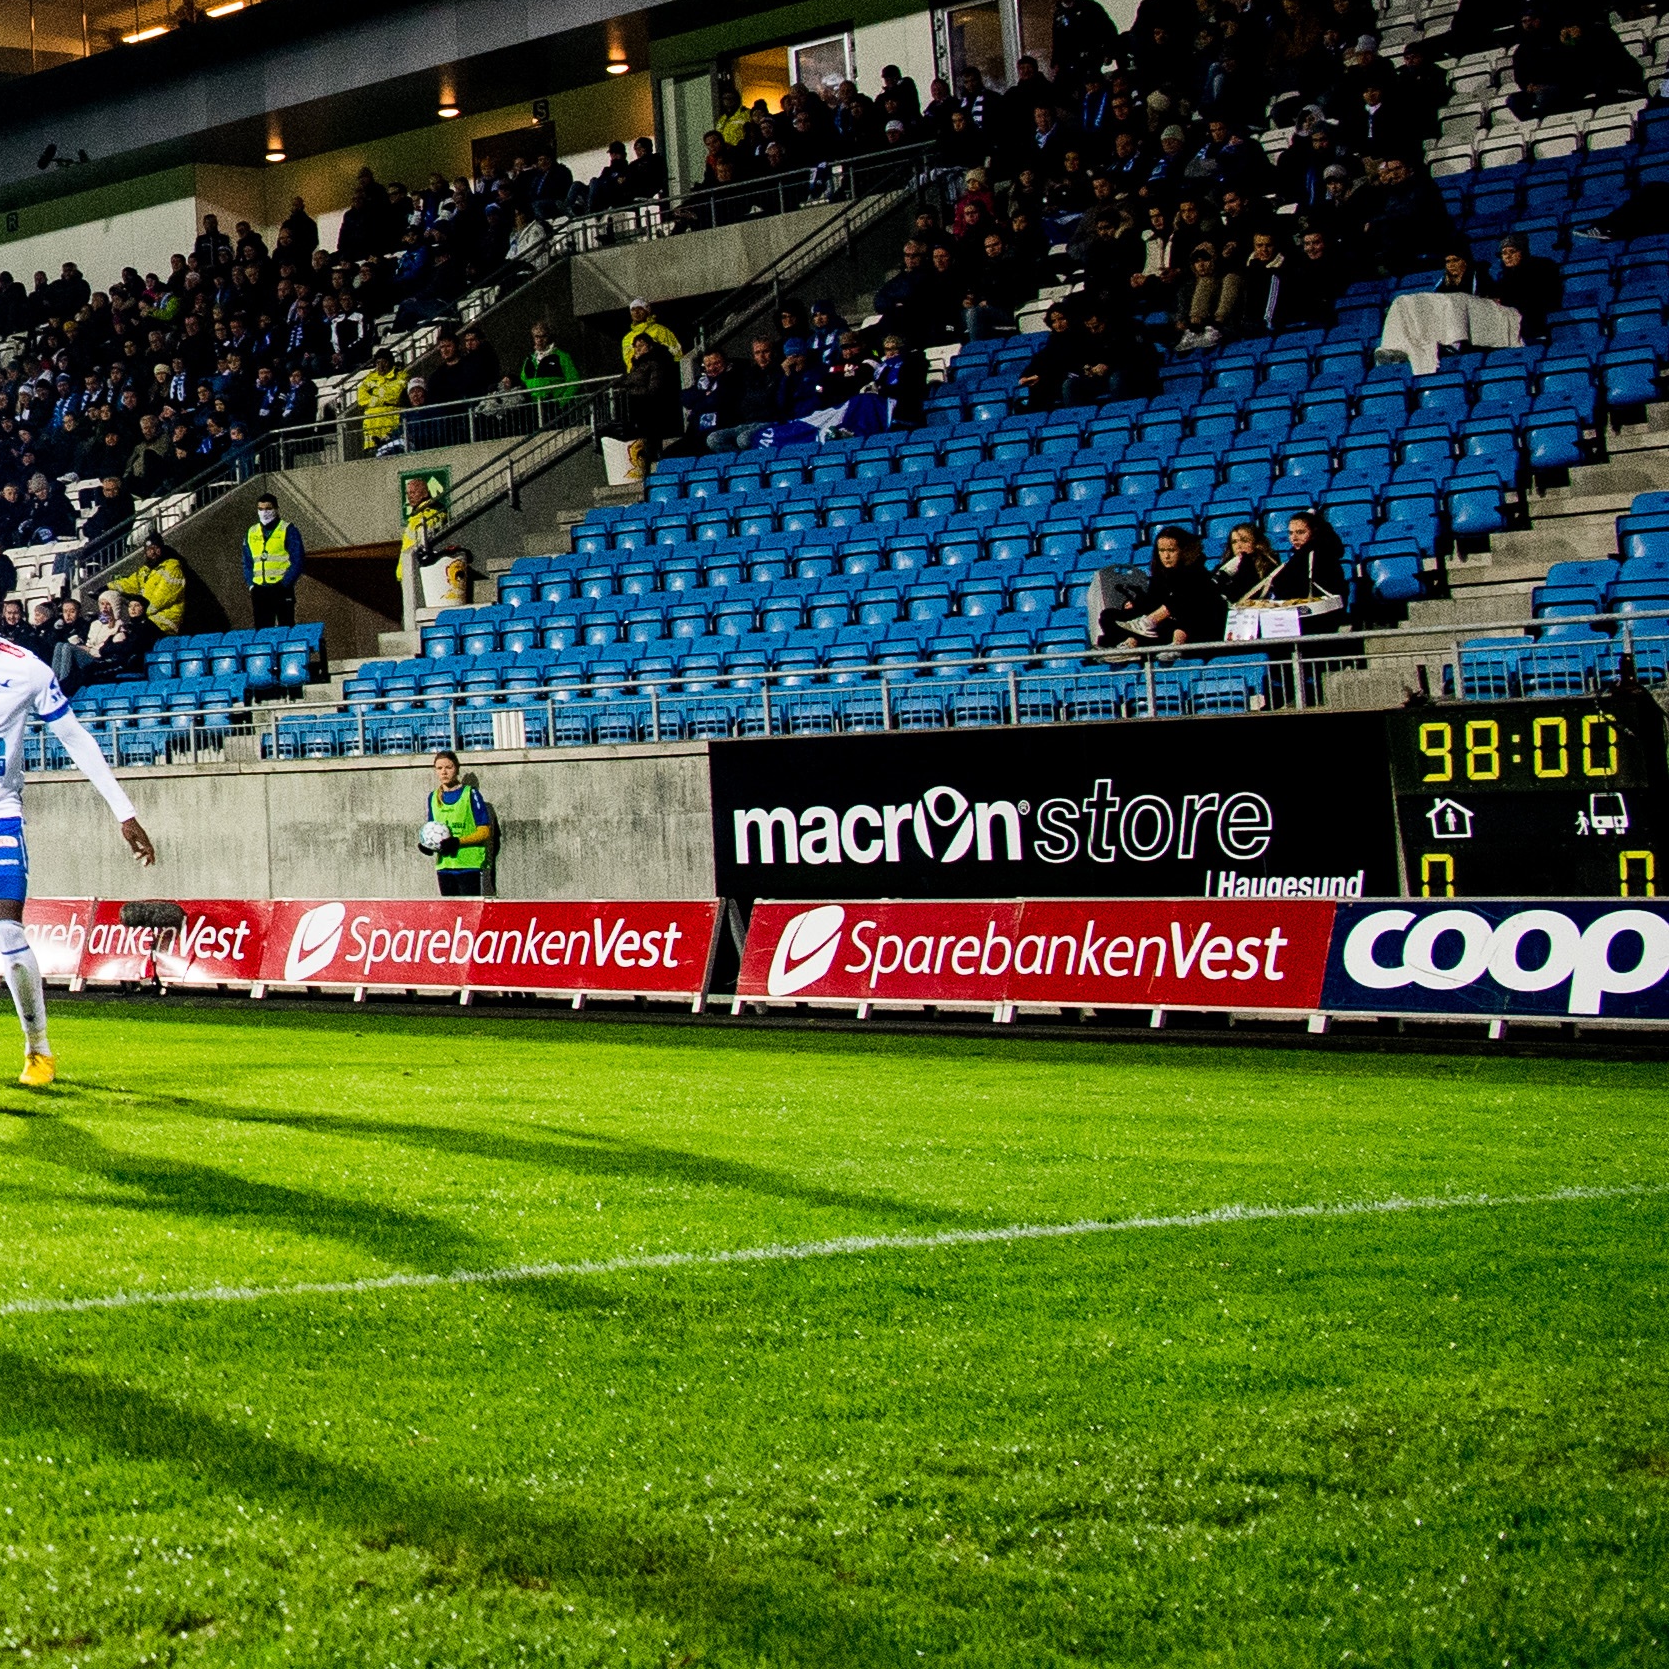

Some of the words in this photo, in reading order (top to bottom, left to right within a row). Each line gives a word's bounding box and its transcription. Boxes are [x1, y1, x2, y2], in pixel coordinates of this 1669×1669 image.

[1419, 714, 1618, 782] 98:00
[1034, 779, 1273, 863] store
[1219, 870, 1365, 897] Haugesund
[1344, 908, 1669, 1014] coop
